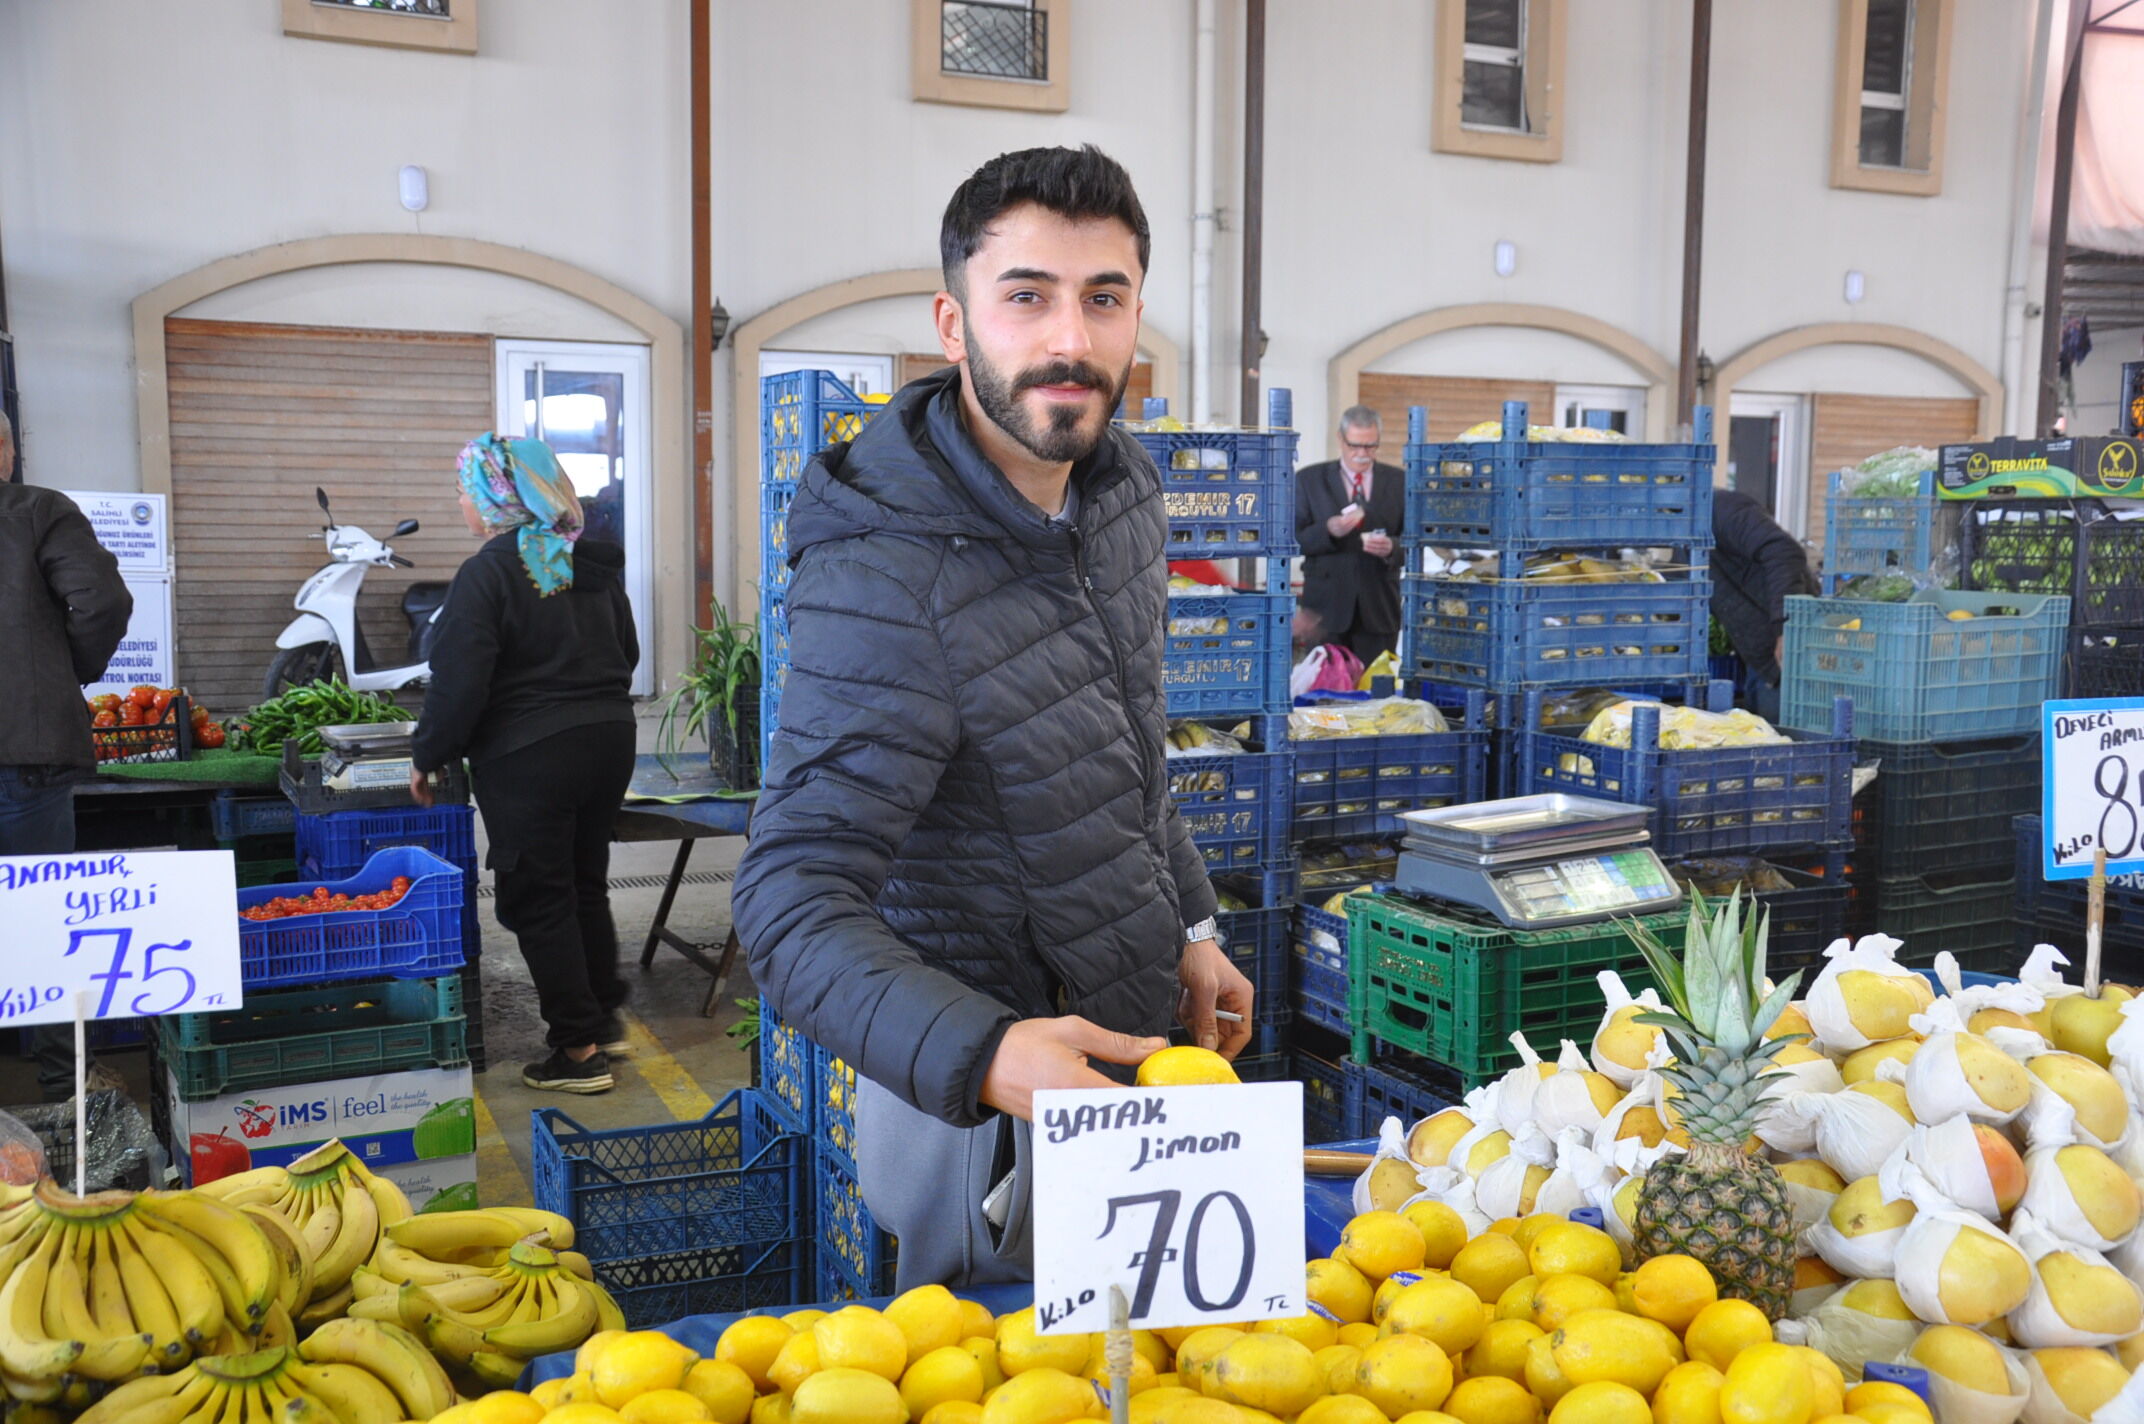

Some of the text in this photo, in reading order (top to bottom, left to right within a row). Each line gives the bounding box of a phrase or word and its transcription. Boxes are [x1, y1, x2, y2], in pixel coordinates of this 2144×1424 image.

[63, 928, 196, 1018] 75
[203, 992, 228, 1005] TL
[343, 1093, 387, 1118] feel
[1044, 1097, 1167, 1143] YATAK
[1096, 1189, 1255, 1320] 70
[1263, 1295, 1290, 1312] TL
